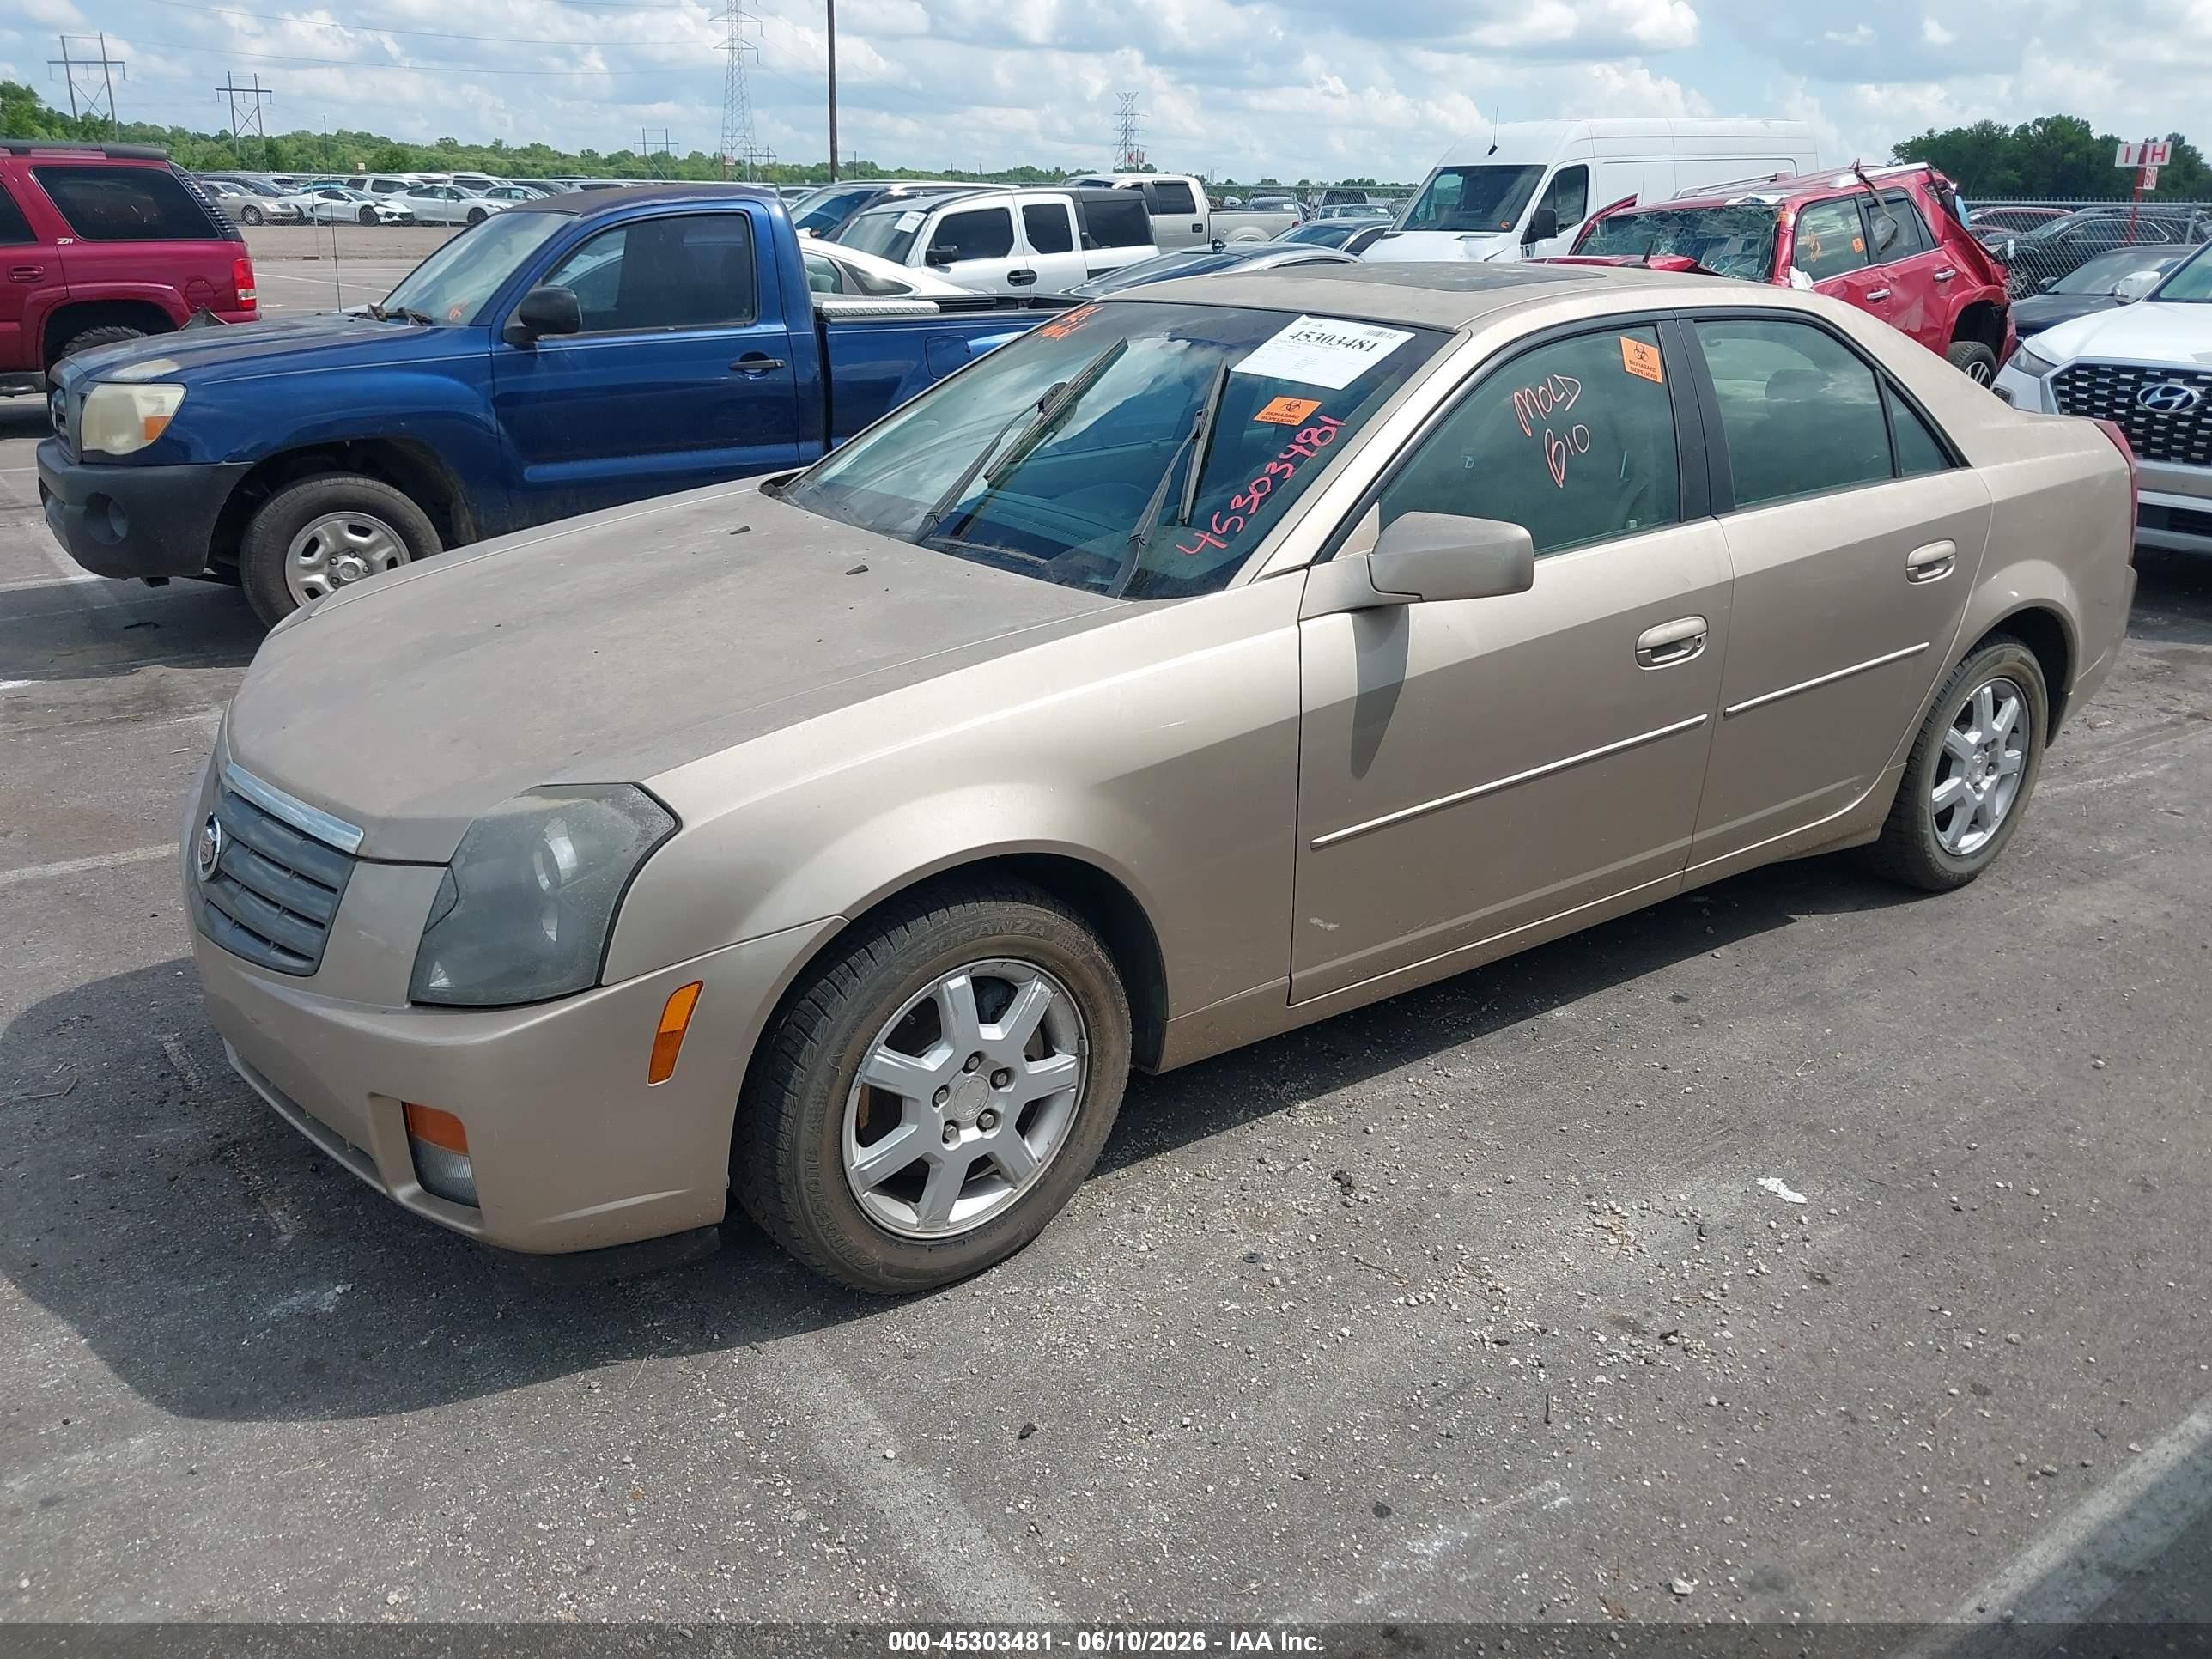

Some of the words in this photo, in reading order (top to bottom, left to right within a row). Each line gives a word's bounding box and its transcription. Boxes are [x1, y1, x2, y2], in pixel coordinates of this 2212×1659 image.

[1127, 152, 1133, 163] K
[1139, 152, 1145, 163] J
[2150, 144, 2167, 163] H
[2145, 168, 2157, 186] 60
[1288, 330, 1381, 353] 45303481
[1628, 359, 1657, 373] BIOHAZARD
[1513, 374, 1582, 437] MOLD
[1544, 424, 1590, 489] BIO
[1176, 415, 1346, 555] 45303481
